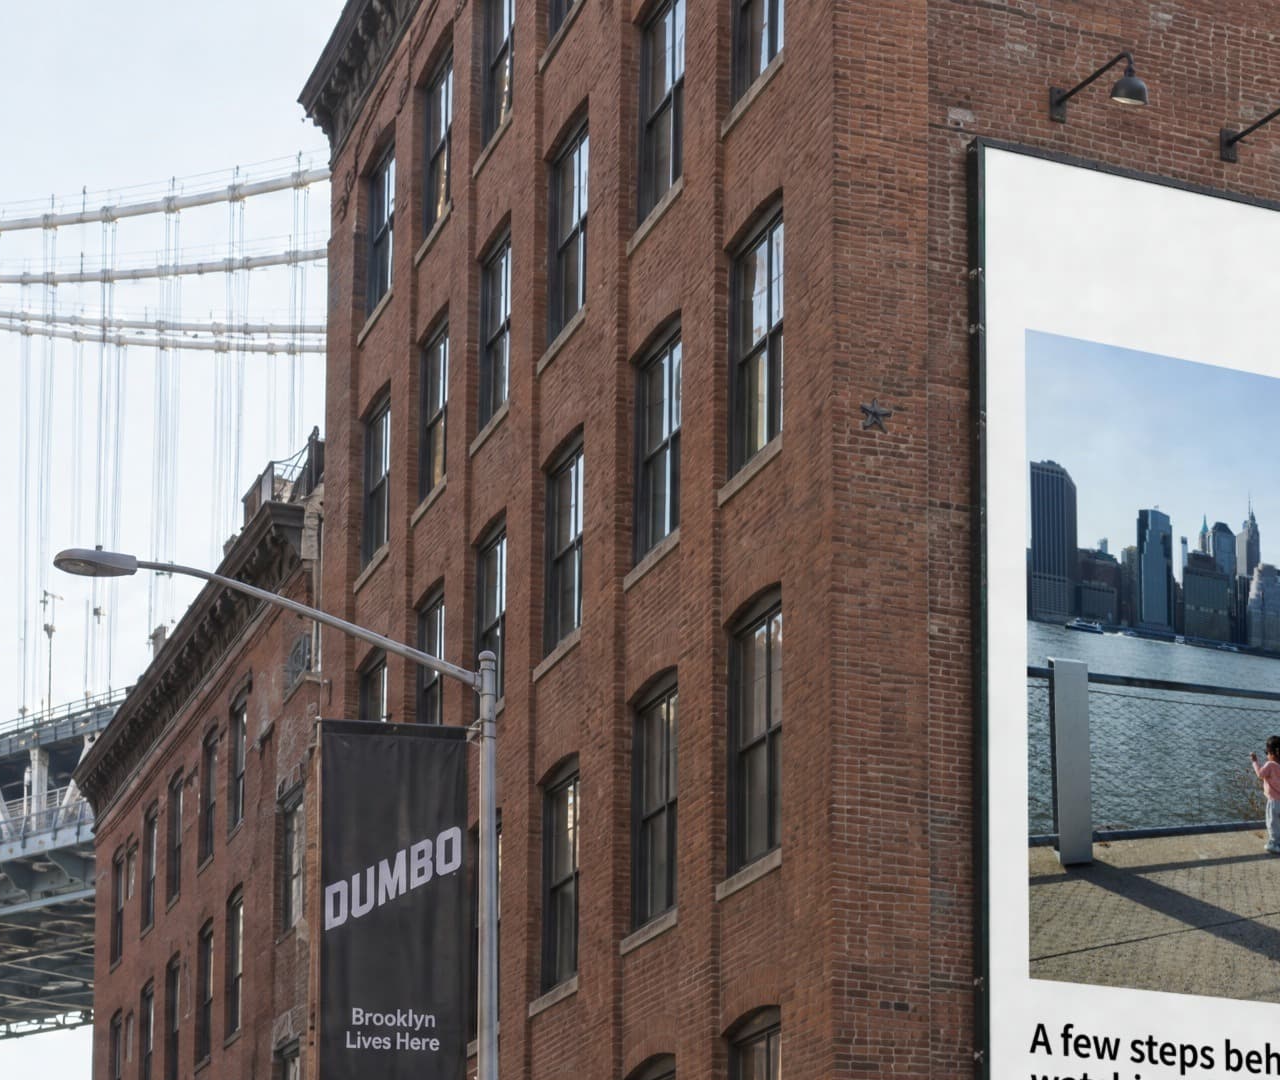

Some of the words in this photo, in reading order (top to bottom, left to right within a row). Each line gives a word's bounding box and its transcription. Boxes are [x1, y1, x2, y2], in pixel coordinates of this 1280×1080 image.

[324, 826, 462, 931] DUMBO
[351, 1007, 436, 1030] Brooklyn
[345, 1030, 392, 1050] Lives
[396, 1031, 440, 1052] Here
[1029, 1022, 1053, 1056] A
[1060, 1023, 1121, 1061] few
[1129, 1034, 1215, 1076] steps
